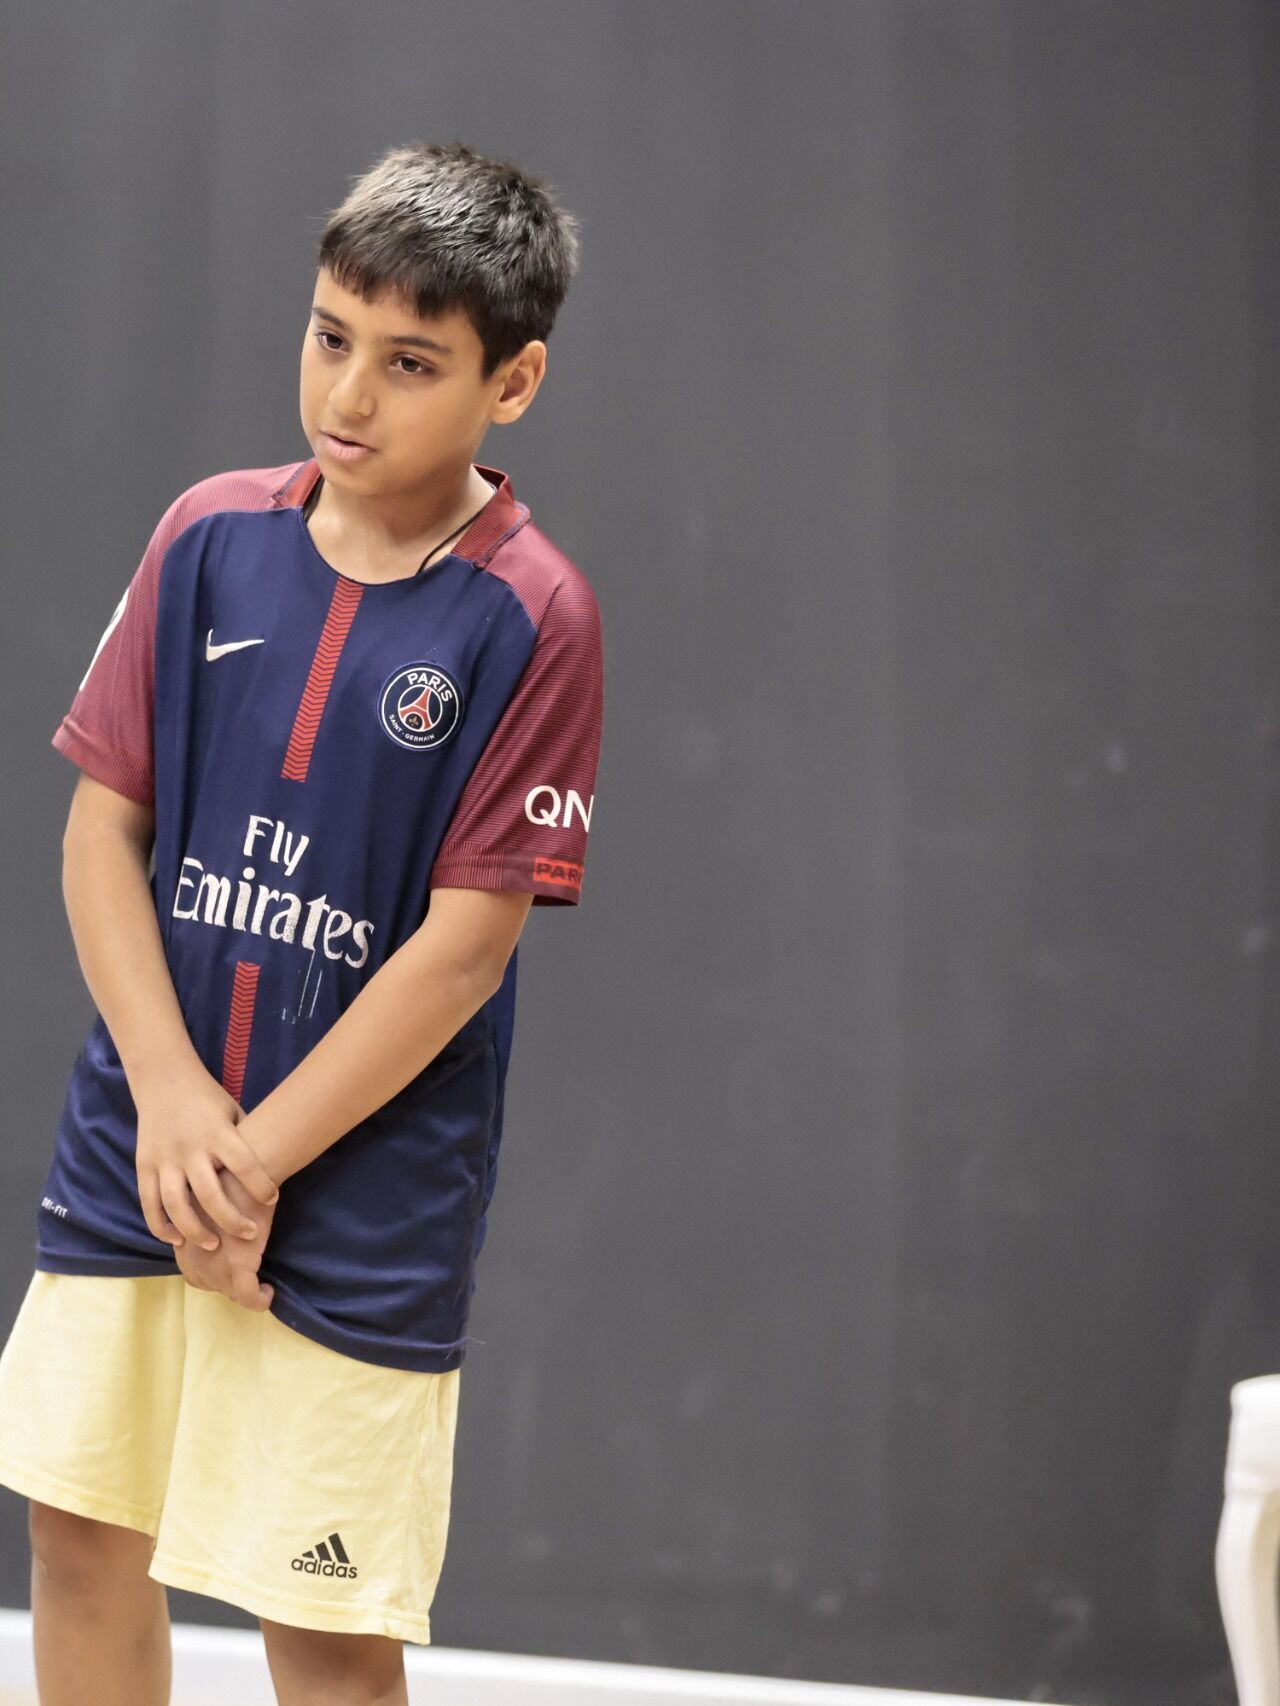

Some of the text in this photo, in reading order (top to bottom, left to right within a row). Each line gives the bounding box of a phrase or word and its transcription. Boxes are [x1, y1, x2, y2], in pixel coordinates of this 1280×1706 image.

[407, 672, 453, 702] PARIS
[243, 814, 310, 876] Fly
[172, 856, 375, 969] Emirates
[291, 1558, 358, 1579] adidas
